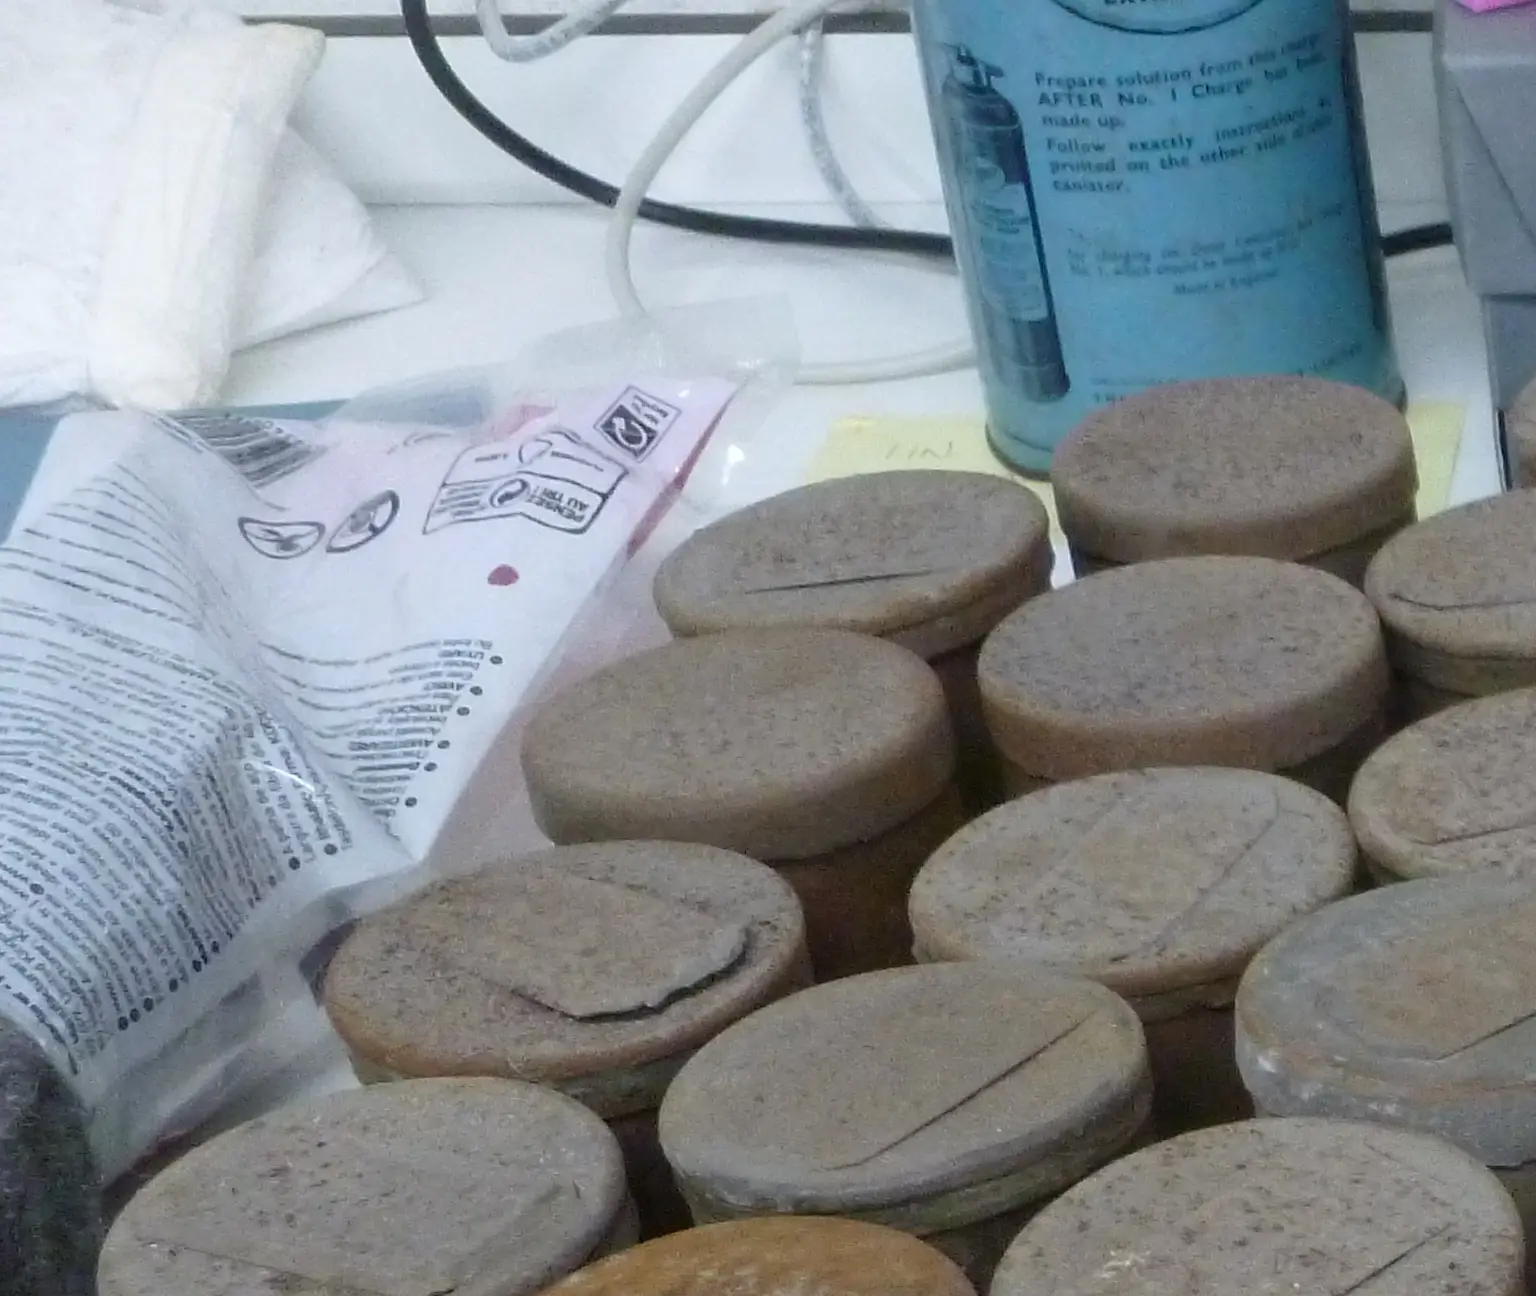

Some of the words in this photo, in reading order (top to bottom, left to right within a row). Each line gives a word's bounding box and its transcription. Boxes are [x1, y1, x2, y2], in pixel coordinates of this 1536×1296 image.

[1035, 71, 1107, 90] Prepare
[1116, 68, 1192, 87] solution
[1200, 59, 1243, 77] from
[1038, 91, 1104, 108] AFTER
[1192, 77, 1254, 98] Charge
[1042, 113, 1090, 128] made
[1046, 137, 1105, 152] Follow
[1128, 133, 1195, 153] exactly
[1050, 158, 1116, 175] printed
[1126, 160, 1150, 173] on
[1160, 152, 1190, 170] the
[1200, 145, 1247, 165] other
[567, 497, 589, 511] AU
